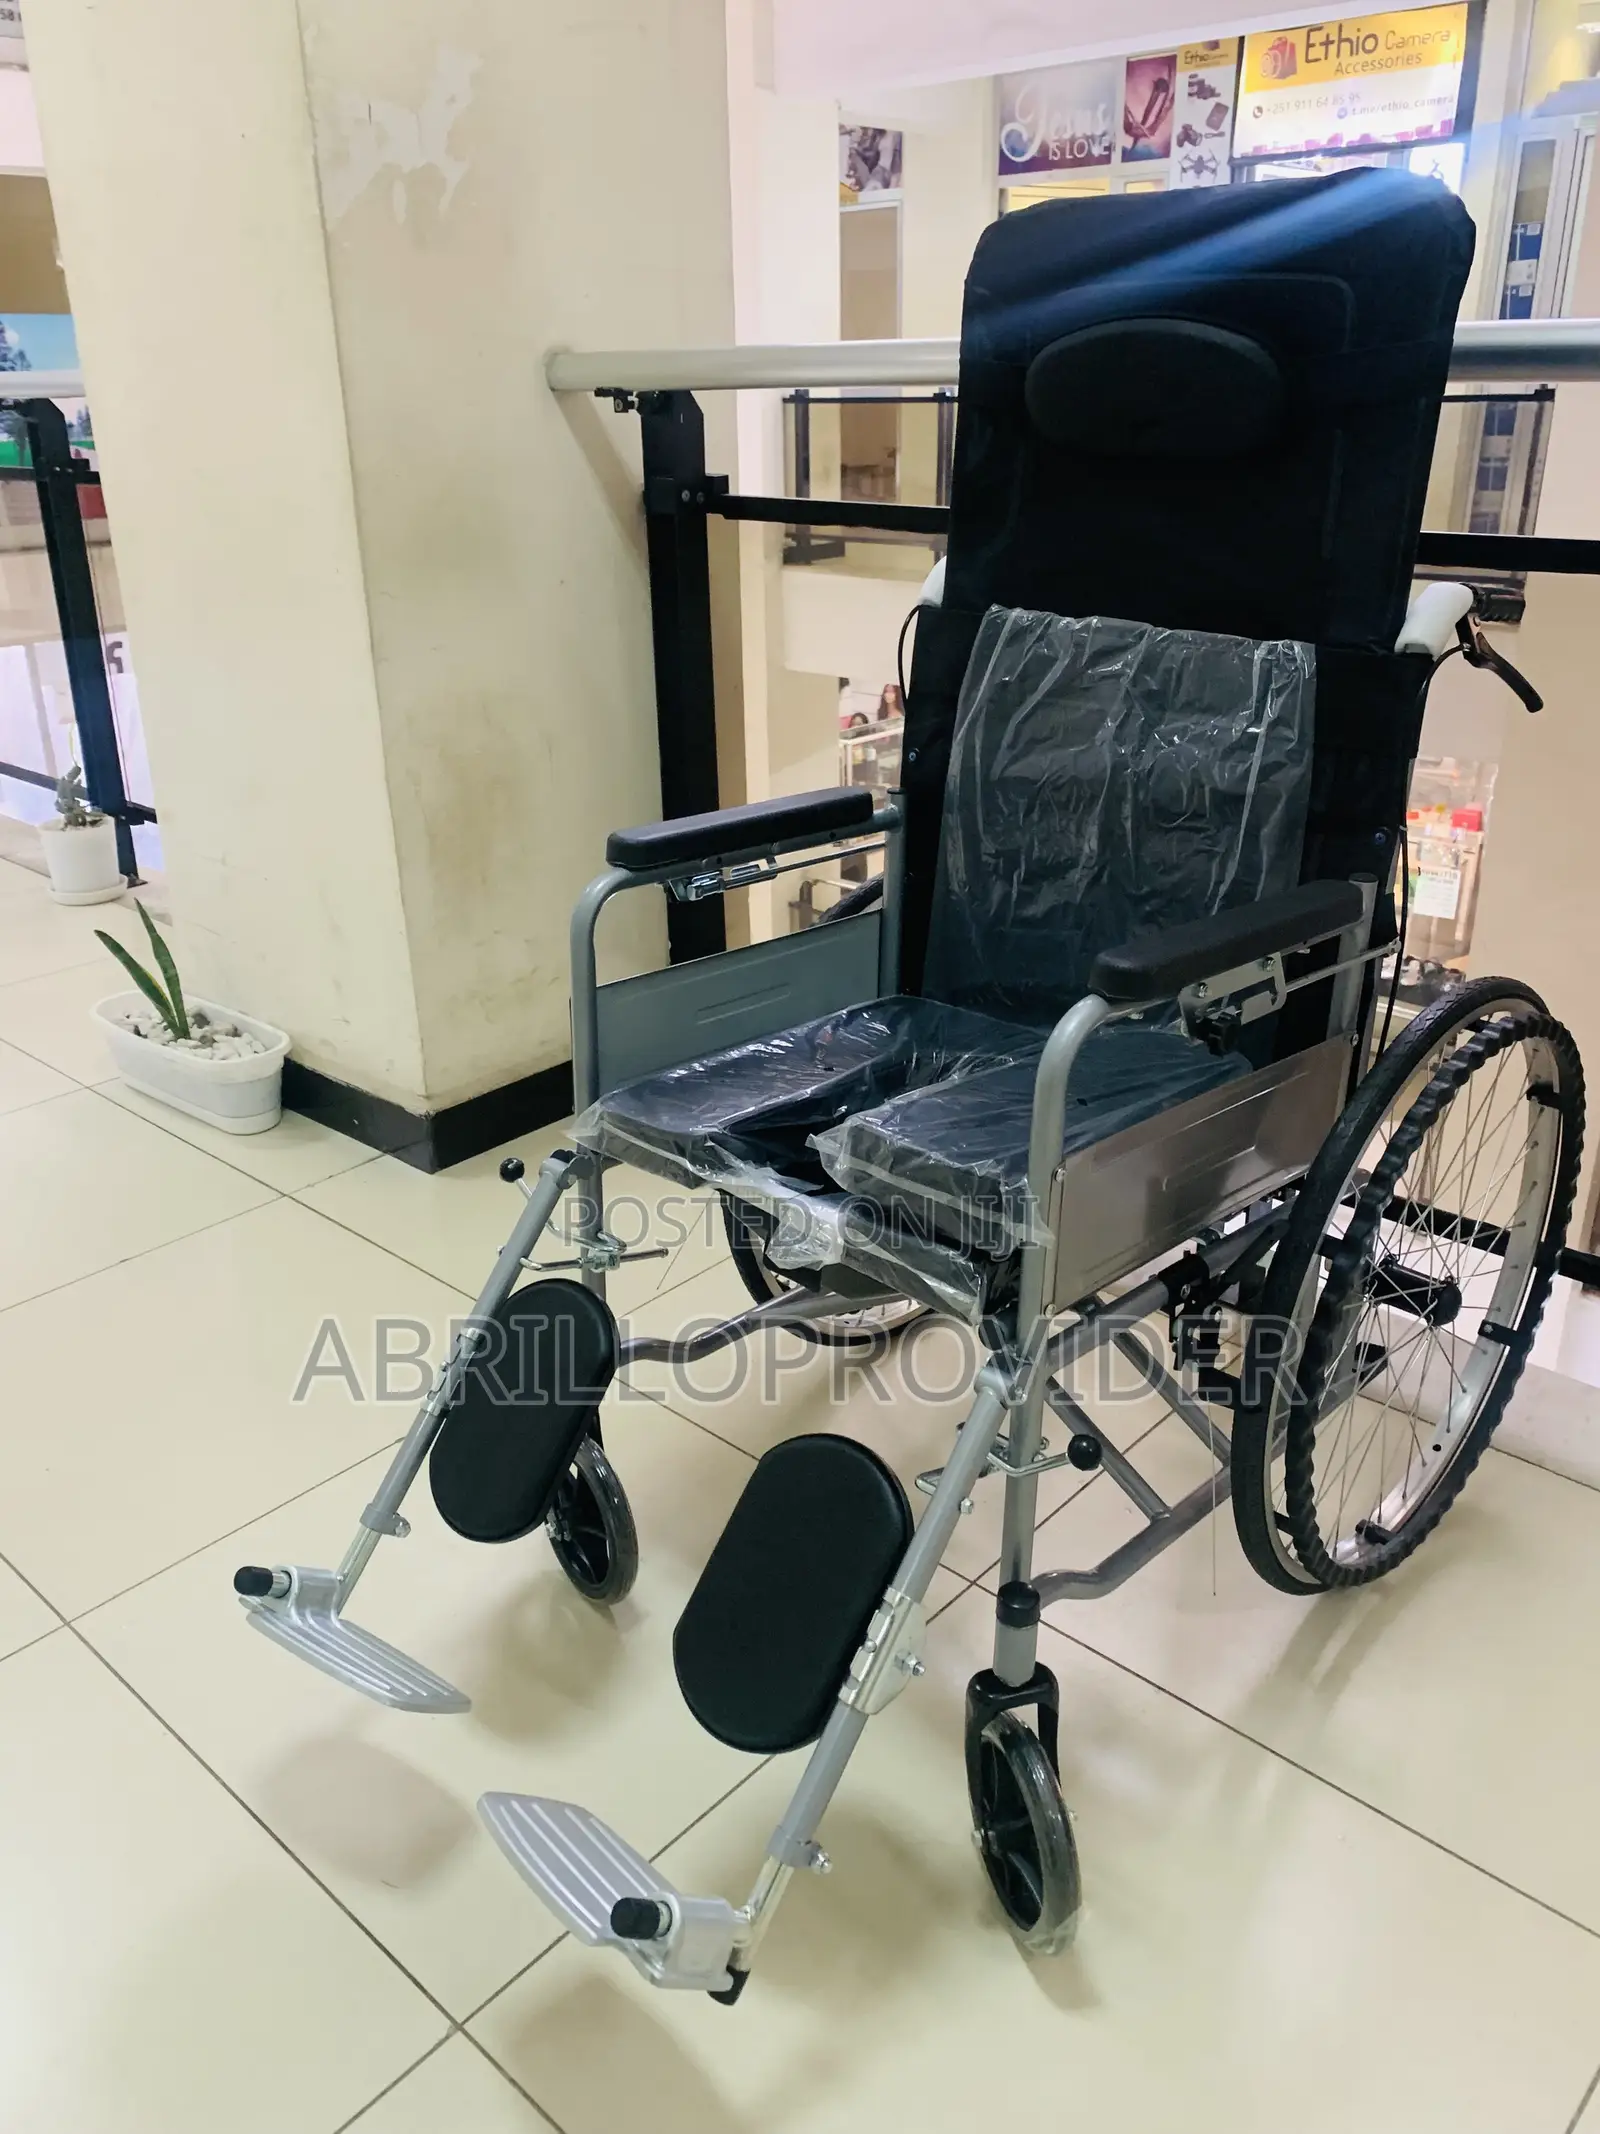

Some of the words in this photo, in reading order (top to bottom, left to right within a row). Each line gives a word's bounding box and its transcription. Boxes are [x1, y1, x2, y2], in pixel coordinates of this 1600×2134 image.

[1304, 22, 1379, 64] Ethio
[1385, 29, 1451, 51] Camera
[1333, 52, 1423, 77] Accessories
[1294, 98, 1312, 112] 911
[1048, 141, 1061, 161] IS
[1065, 136, 1111, 160] LOVE
